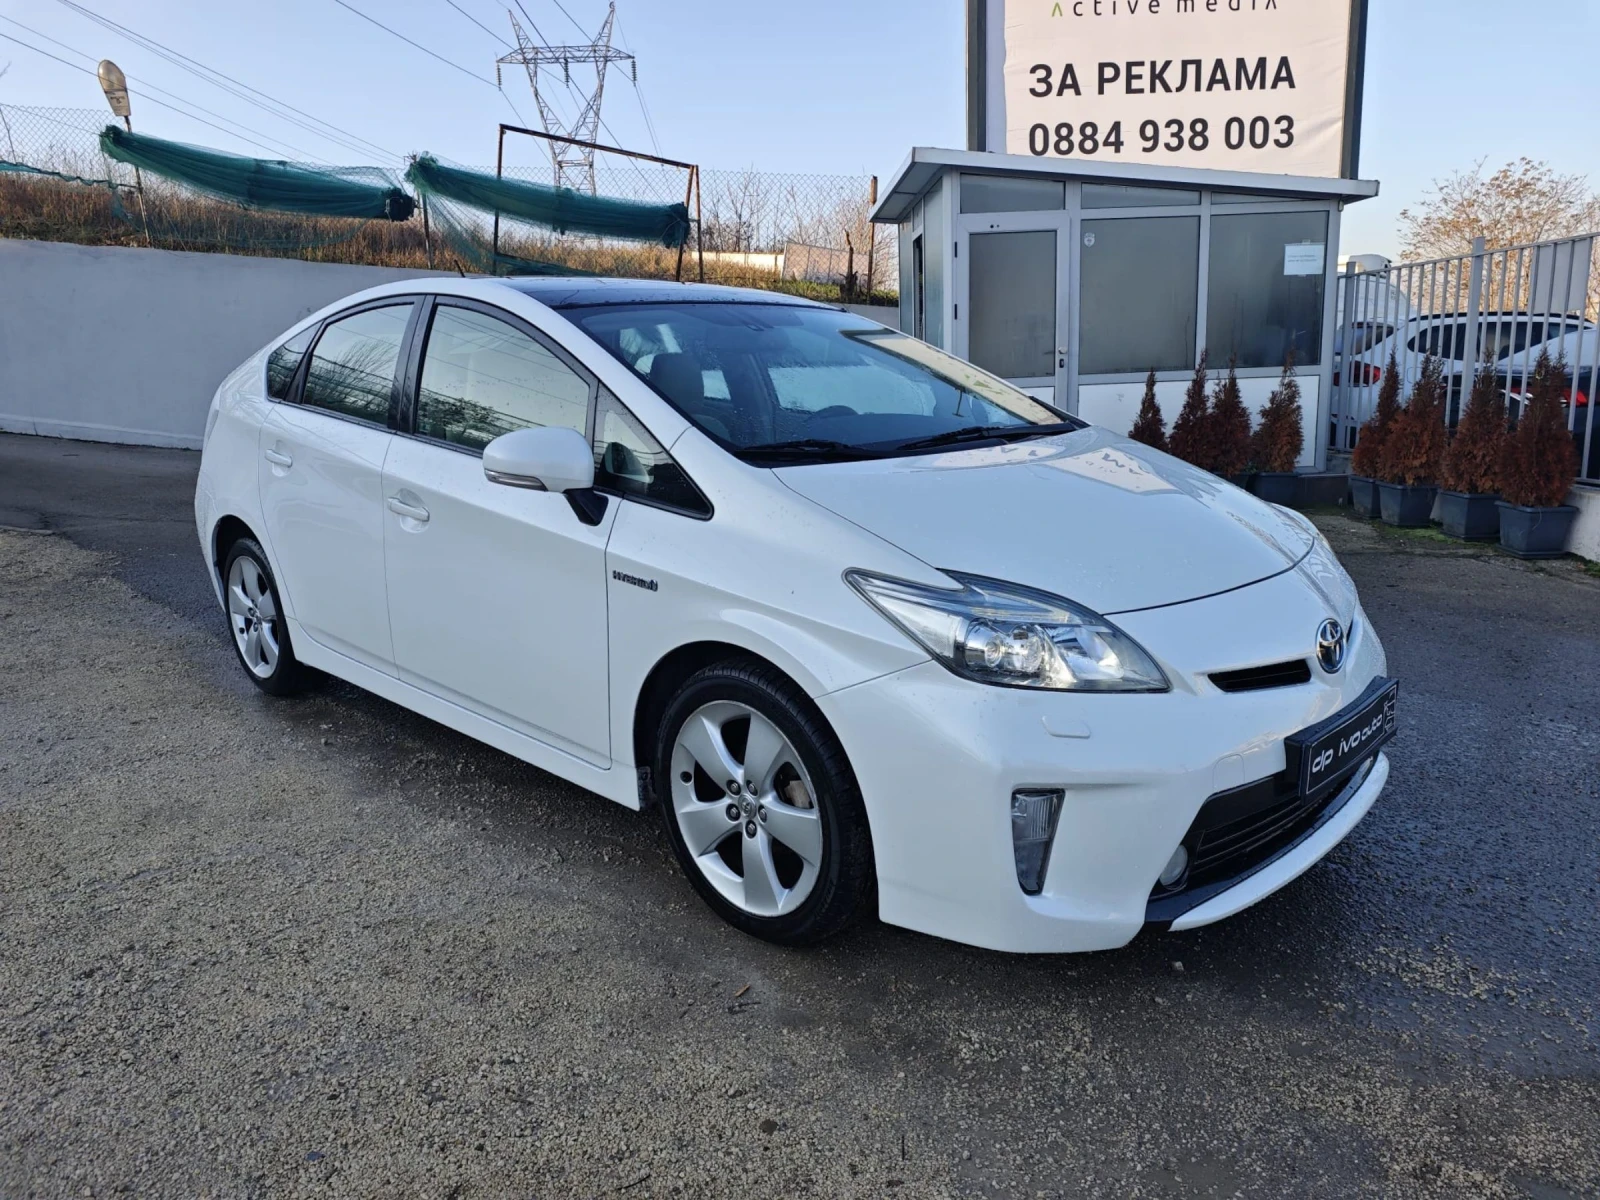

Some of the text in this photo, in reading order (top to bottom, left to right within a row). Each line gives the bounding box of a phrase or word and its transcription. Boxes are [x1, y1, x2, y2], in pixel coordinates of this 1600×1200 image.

[1029, 55, 1296, 98] ЗА РЕКЛАМА
[1029, 114, 1294, 157] 0884 938 003
